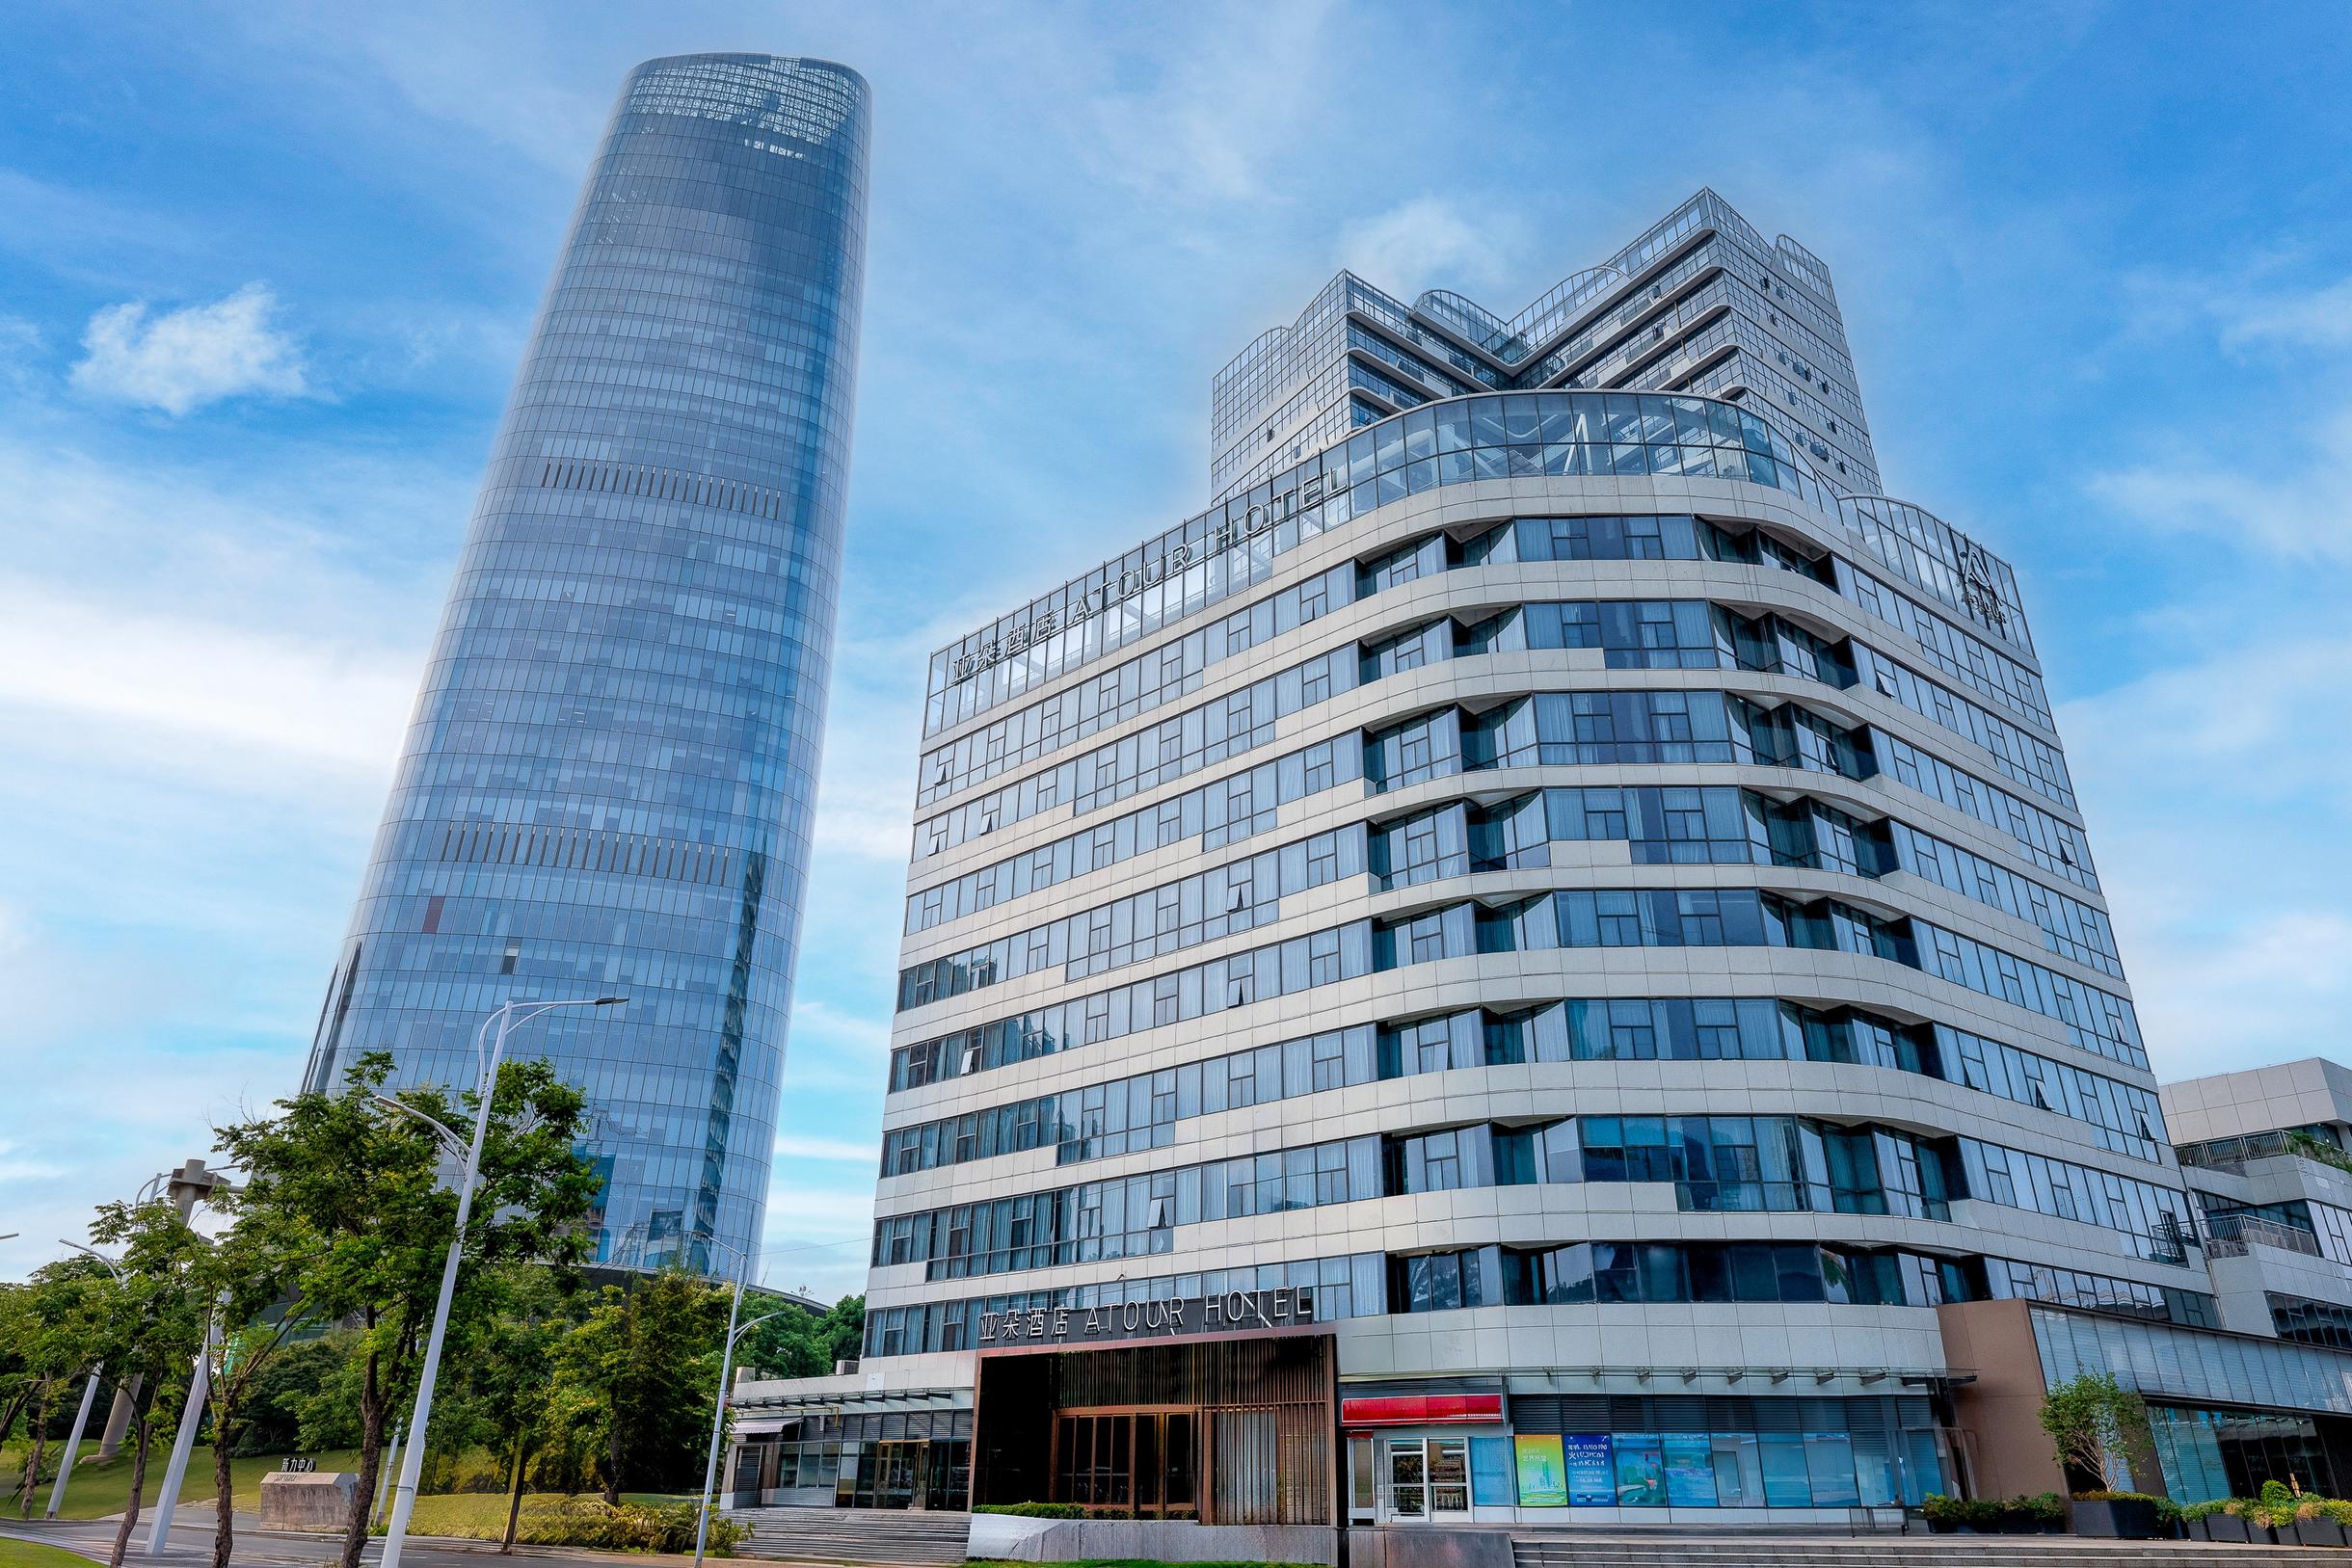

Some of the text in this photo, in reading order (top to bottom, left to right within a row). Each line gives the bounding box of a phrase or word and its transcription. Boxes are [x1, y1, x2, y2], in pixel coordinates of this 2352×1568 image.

[951, 466, 1348, 681] 亚朵酒店 ATOUR HOTEL
[979, 1285, 1312, 1341] 亚朵酒店 ATOUR HOTEL
